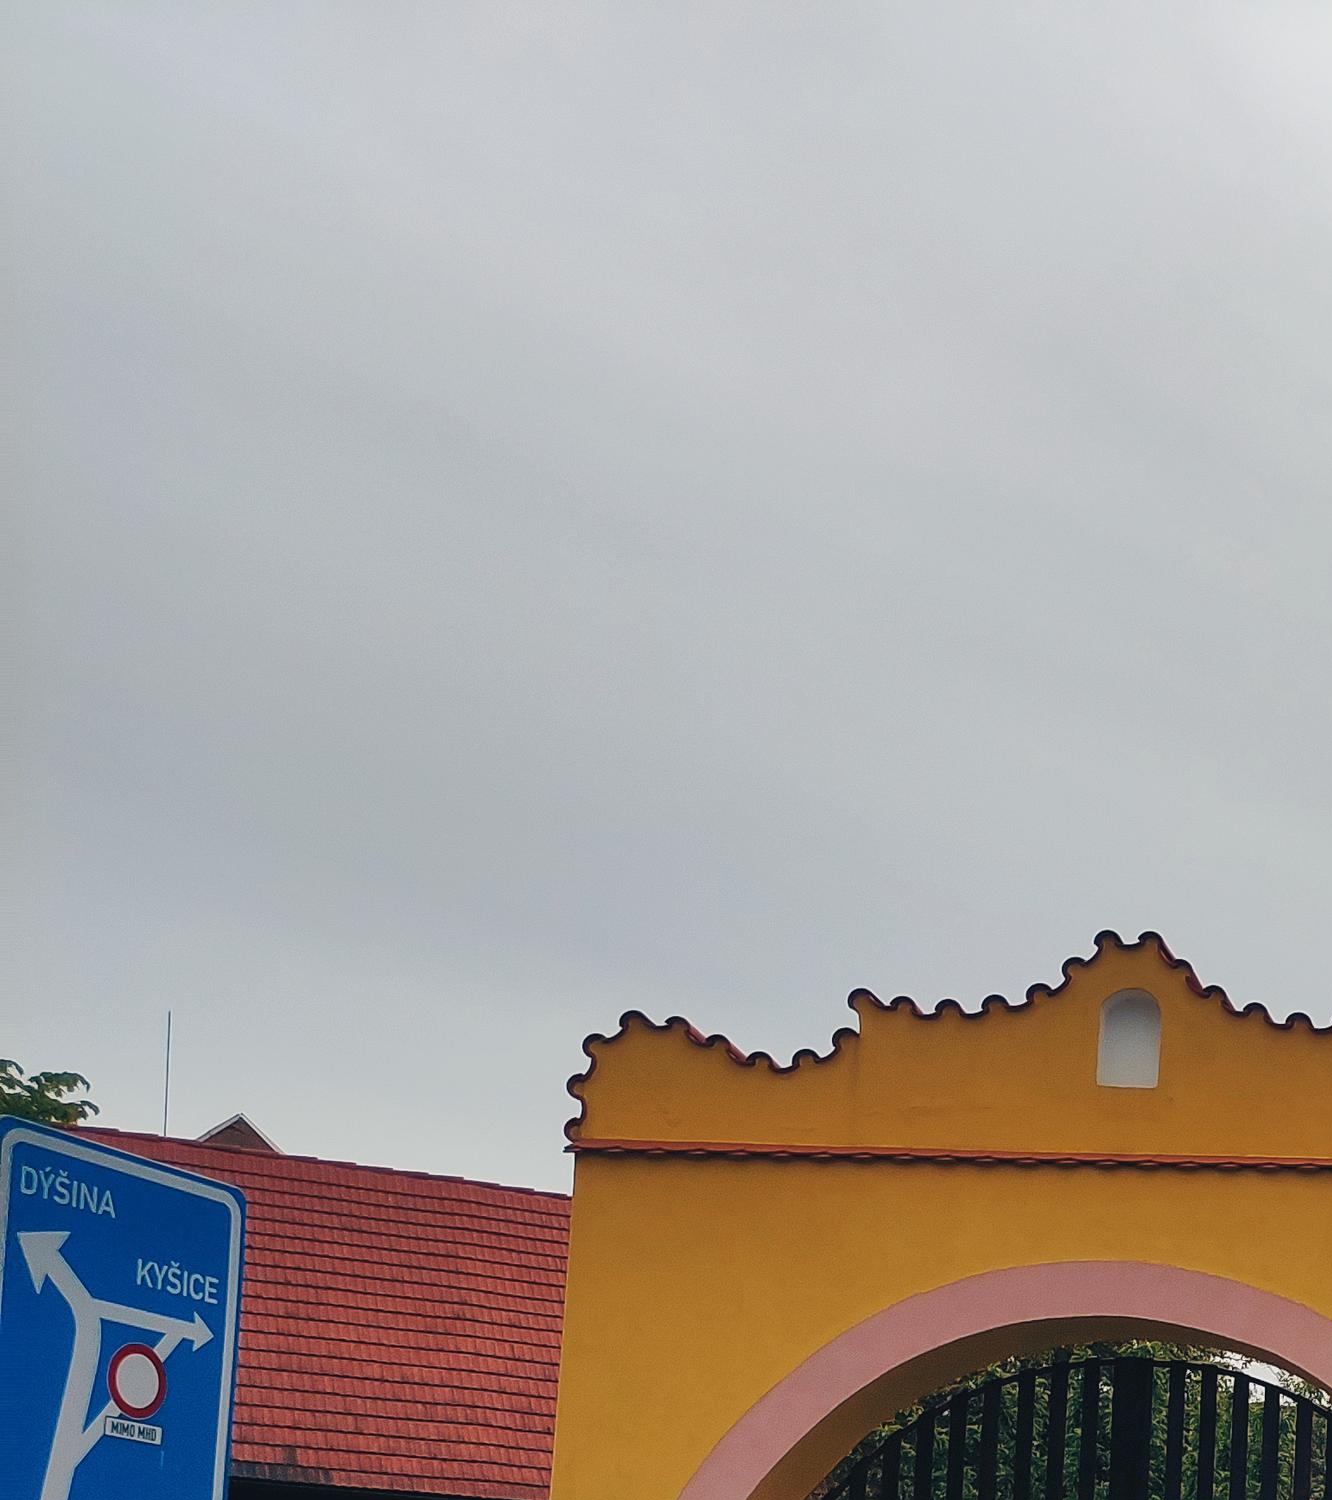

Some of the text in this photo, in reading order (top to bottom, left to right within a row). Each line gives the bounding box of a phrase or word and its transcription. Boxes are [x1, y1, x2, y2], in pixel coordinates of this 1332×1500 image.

[20, 1165, 116, 1219] DÝŠINA
[136, 1258, 220, 1305] KYŠICE
[111, 1420, 157, 1442] MIMO MHD
